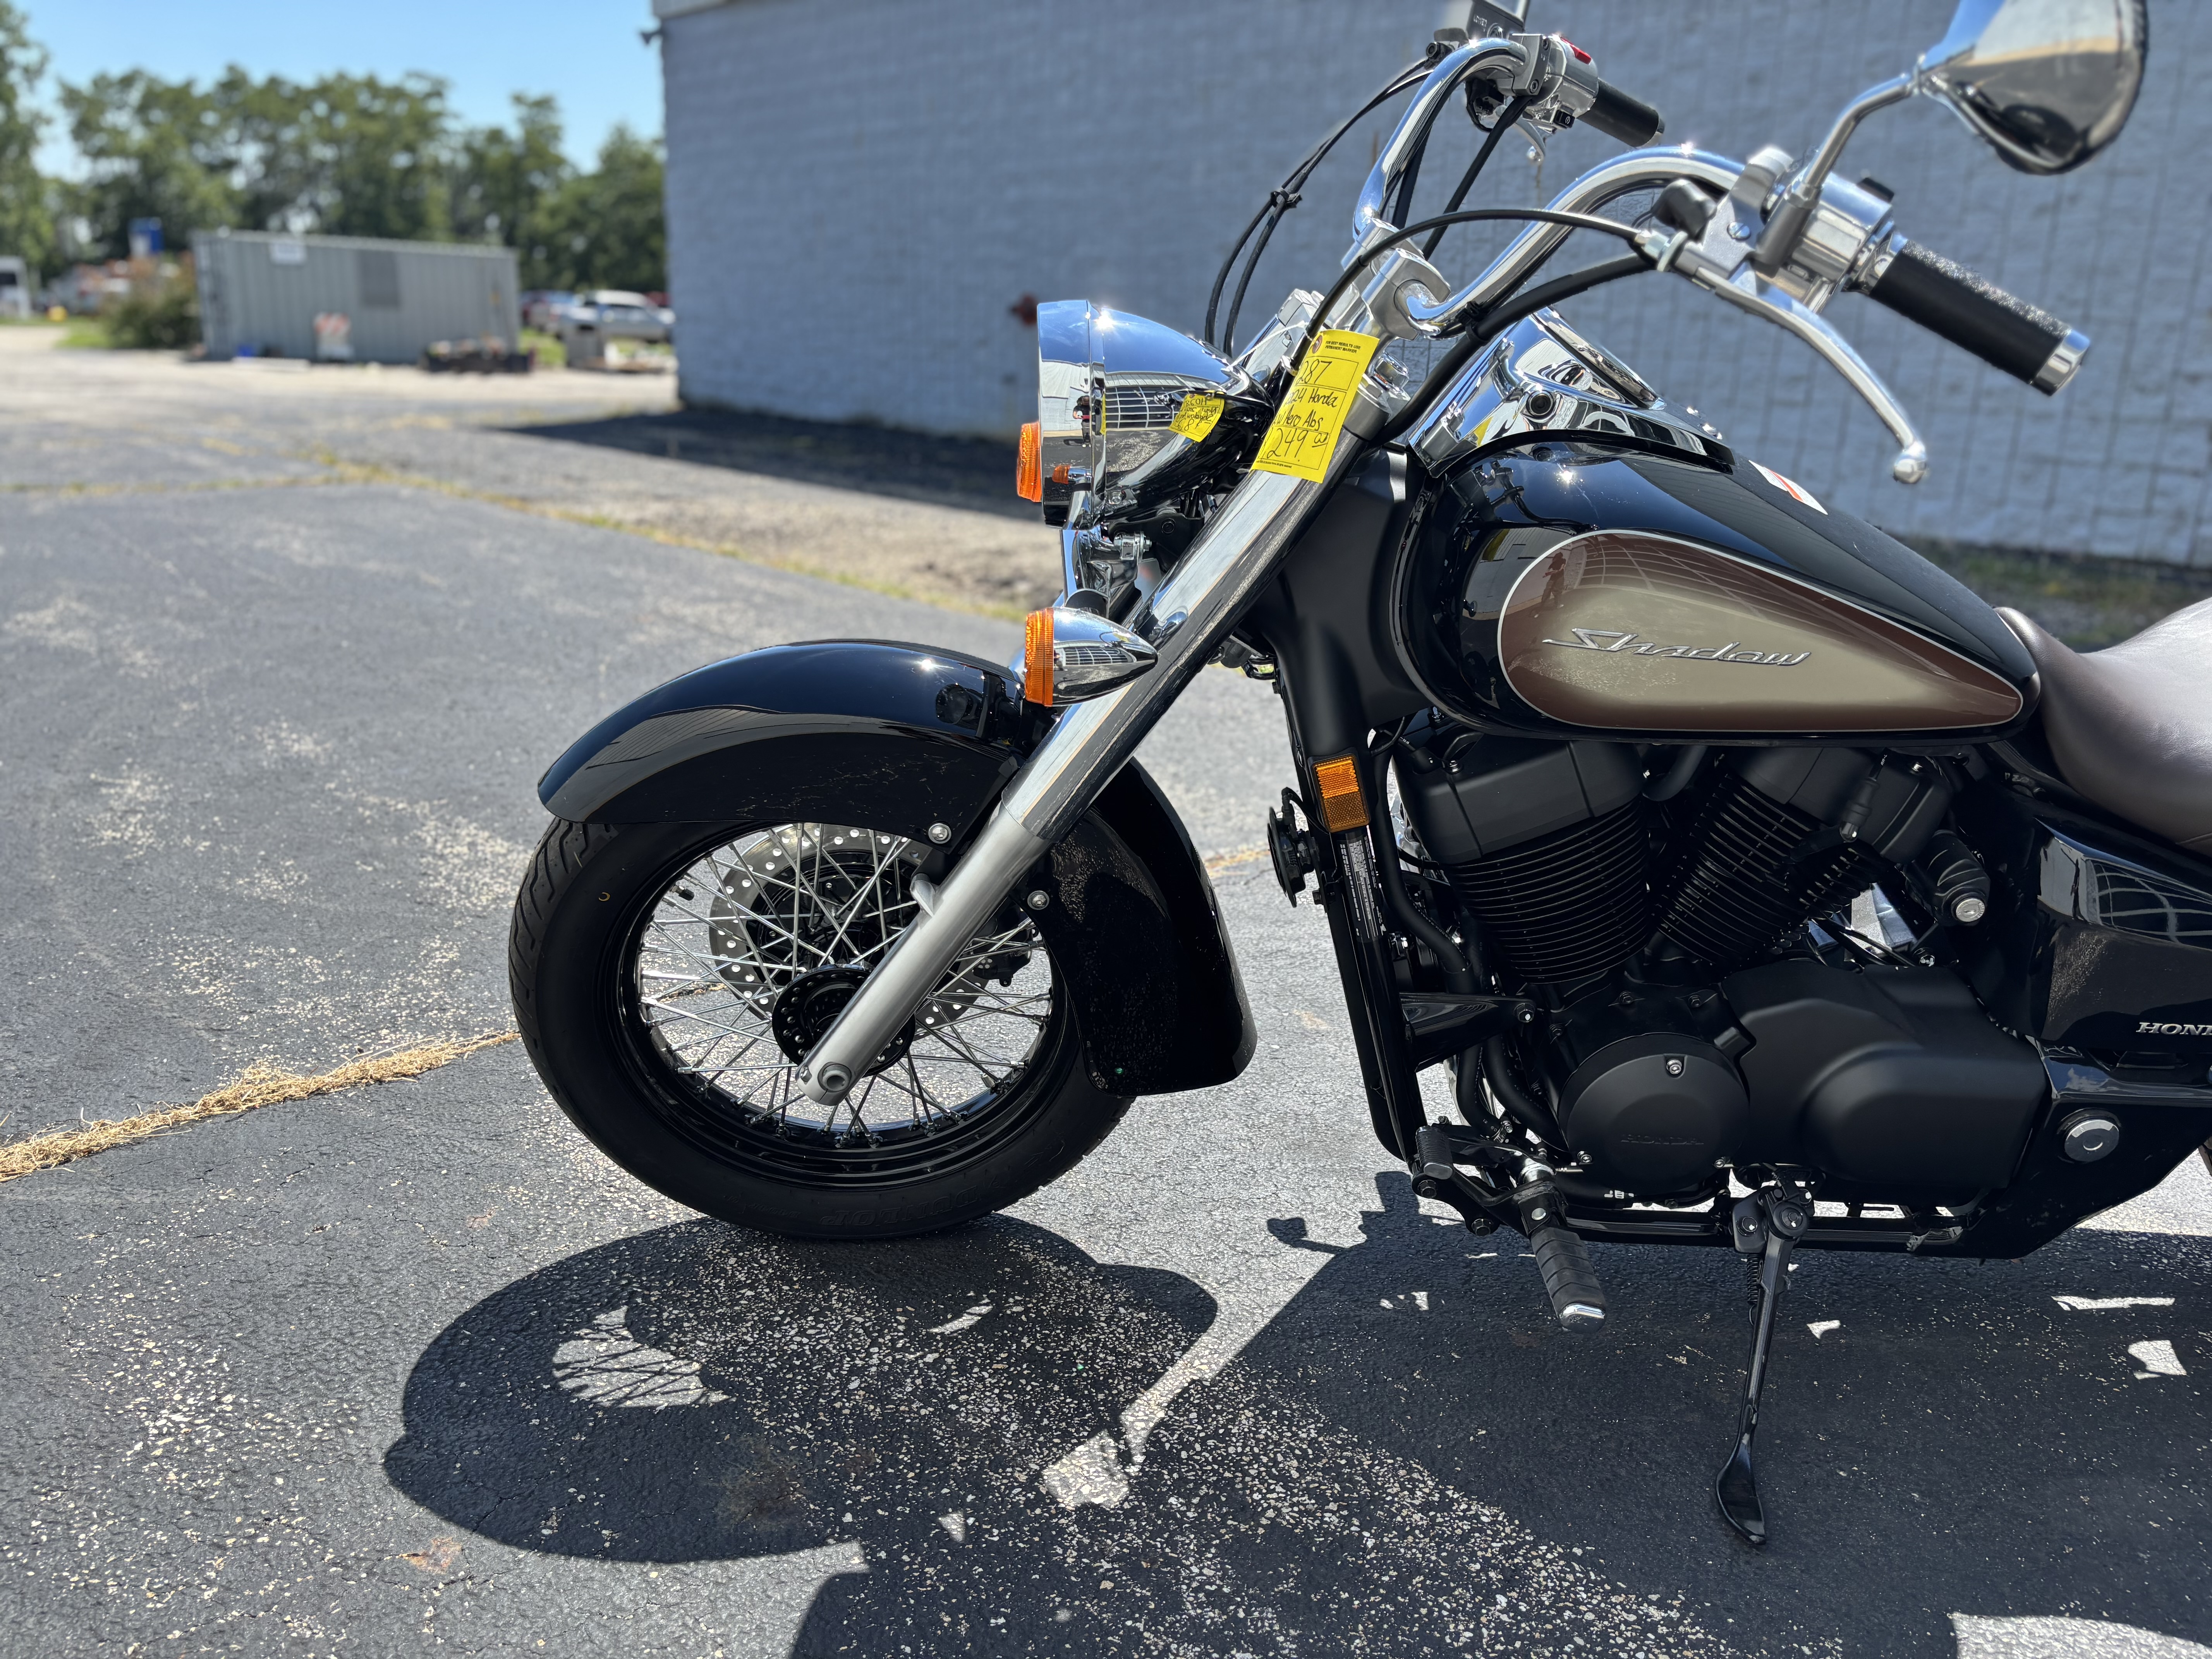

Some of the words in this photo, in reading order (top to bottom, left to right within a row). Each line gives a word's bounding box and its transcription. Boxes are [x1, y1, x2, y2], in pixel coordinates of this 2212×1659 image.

[1308, 388, 1338, 408] Honda
[1542, 628, 1812, 666] Shadow
[819, 1185, 978, 1226] DUNLOP
